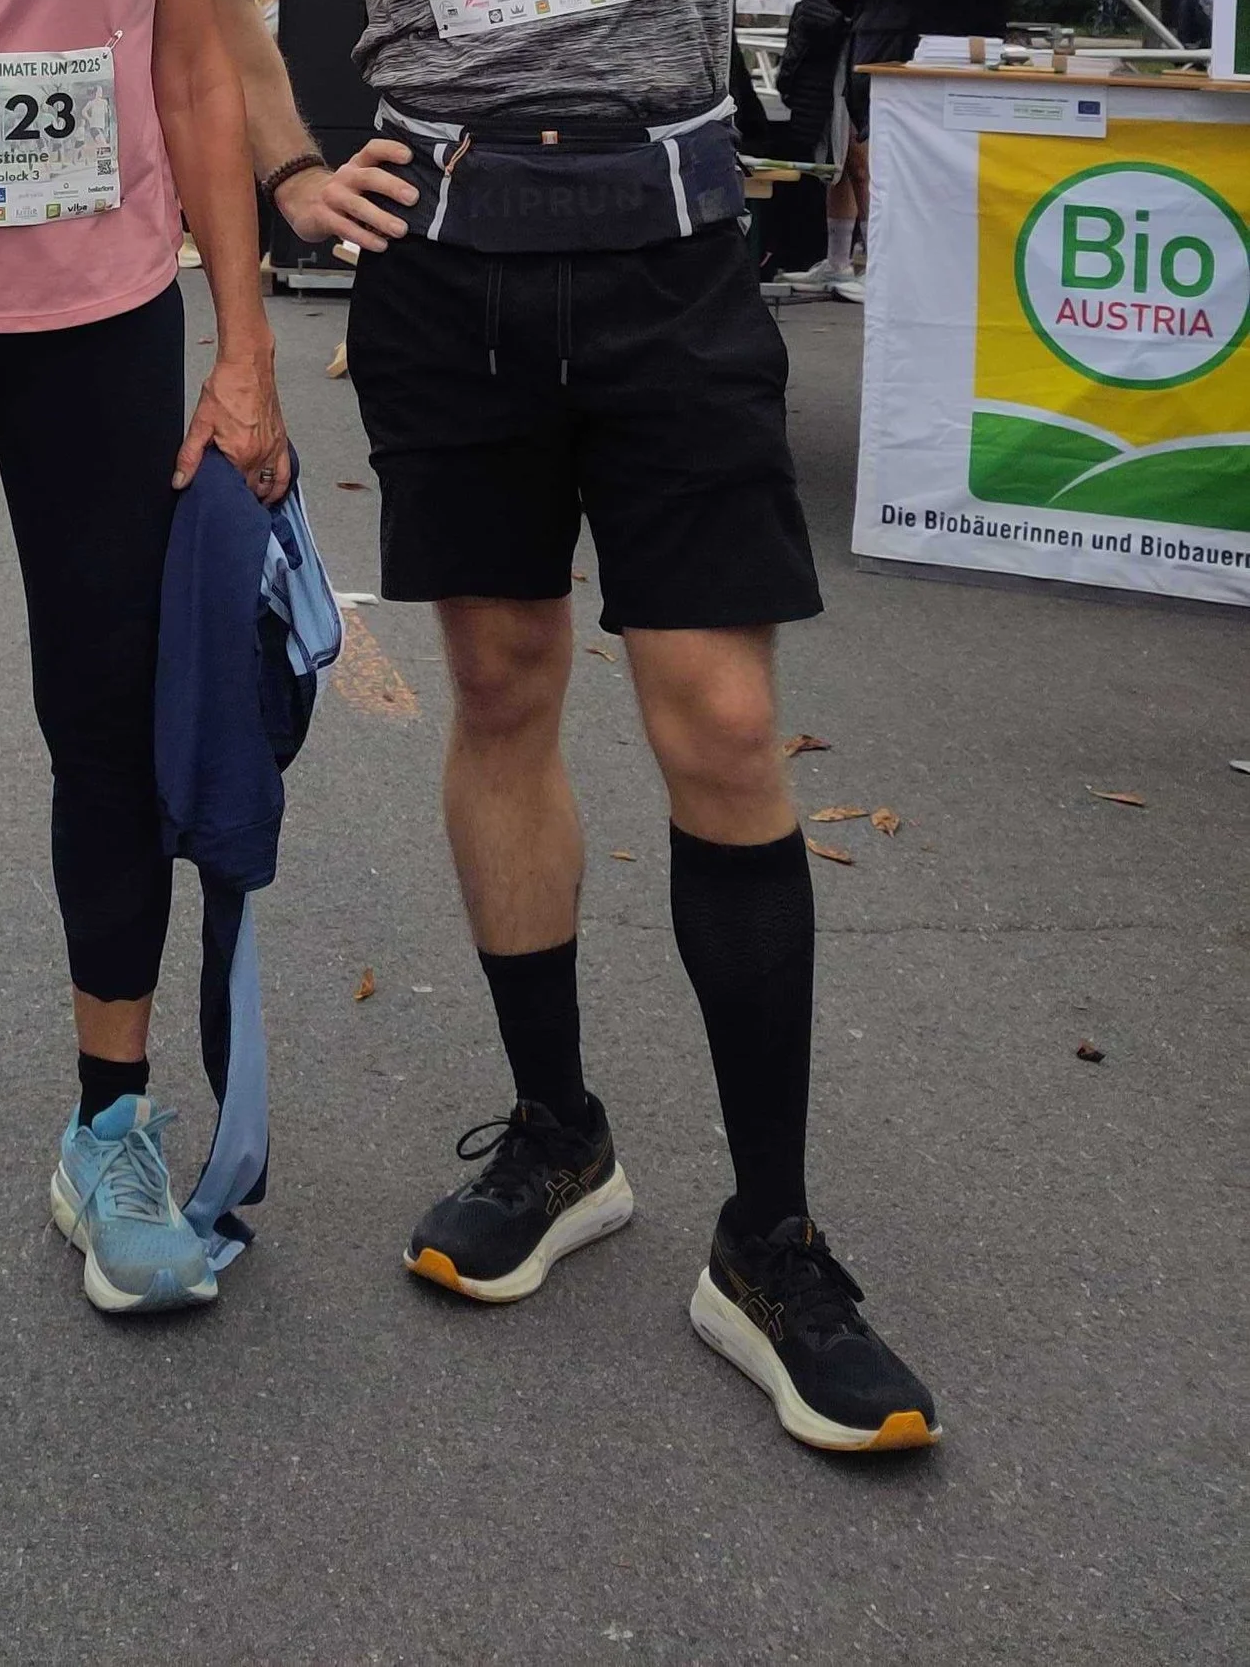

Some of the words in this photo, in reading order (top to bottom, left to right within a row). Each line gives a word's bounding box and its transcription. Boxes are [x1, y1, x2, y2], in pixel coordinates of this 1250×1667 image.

[41, 61, 68, 76] RUN
[70, 58, 101, 74] 2025
[32, 170, 40, 181] 3
[67, 203, 88, 213] vibe
[1061, 204, 1215, 298] Bio
[1055, 297, 1214, 338] AUSTRIA
[881, 504, 916, 527] Die
[925, 509, 1083, 547] Biobäuerinnen
[1092, 533, 1132, 553] und
